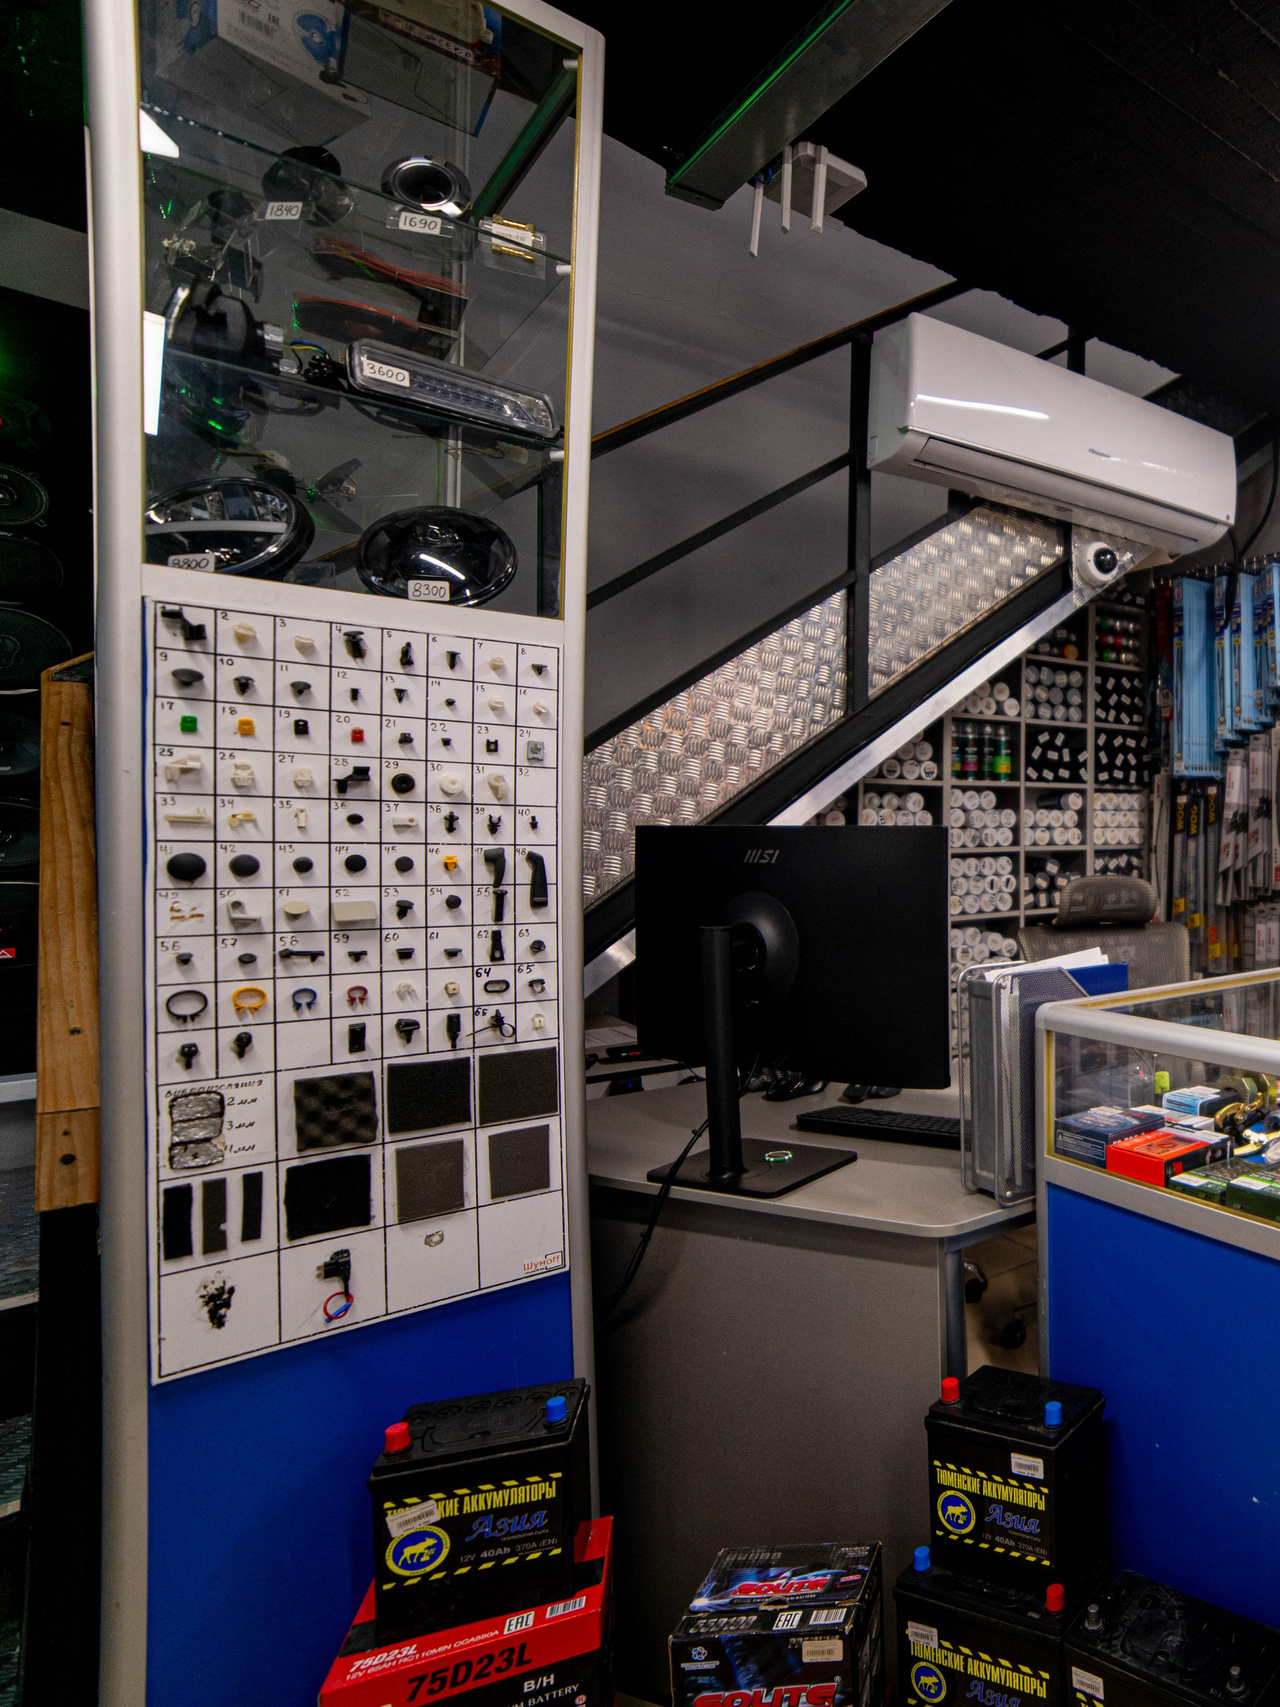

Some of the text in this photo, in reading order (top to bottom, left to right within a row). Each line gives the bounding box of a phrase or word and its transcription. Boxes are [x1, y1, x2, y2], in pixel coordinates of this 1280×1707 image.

[269, 203, 300, 217] 1840
[402, 215, 438, 231] 1690
[366, 362, 406, 383] 3600
[1087, 447, 1112, 460] Hisense
[411, 580, 447, 599] 8300
[220, 611, 230, 620] 2
[279, 618, 286, 627] 3
[520, 647, 527, 655] 8
[159, 651, 168, 661] 9
[219, 658, 235, 666] 10
[280, 664, 289, 672] 11
[336, 671, 348, 679] 12
[385, 675, 395, 683] 13
[431, 679, 441, 687] 14
[476, 684, 486, 692] 15
[160, 701, 175, 710] 17
[222, 706, 237, 715] 18
[278, 709, 291, 718] 19
[335, 715, 351, 723] 20
[385, 719, 396, 728] 21
[430, 722, 448, 732] 22
[477, 725, 490, 734] 23
[519, 729, 531, 738] 24
[158, 748, 174, 757] 25
[219, 752, 236, 760] 26
[278, 754, 295, 763] 27
[334, 757, 349, 766] 28
[384, 760, 399, 769] 29
[429, 763, 443, 771] 30
[475, 766, 485, 774] 31
[517, 768, 530, 777] 32
[160, 796, 176, 806] 33
[219, 799, 235, 808] 34
[278, 800, 293, 809] 35
[333, 802, 347, 810] 36
[385, 803, 400, 812] 37
[429, 805, 442, 813] 38
[475, 807, 485, 815] 39
[517, 808, 531, 816] 40
[1190, 804, 1198, 835] WOG
[220, 844, 236, 853] 42
[278, 845, 295, 854] 43
[384, 845, 397, 854] 45
[428, 847, 440, 855] 46
[515, 847, 527, 856] 48
[278, 889, 290, 898] 51
[335, 888, 350, 897] 52
[384, 887, 399, 897] 53
[429, 887, 443, 896] 54
[476, 887, 491, 897] 55
[429, 931, 439, 941] 61
[477, 931, 489, 939] 62
[518, 928, 530, 938] 63
[279, 936, 299, 948] 58
[333, 933, 350, 944] 59
[384, 933, 399, 943] 60
[221, 937, 238, 949] 57
[475, 967, 492, 978] 64
[517, 964, 536, 975] 65
[936, 1467, 1046, 1511] ТЮМЕНСКИЕ АККУМУЛЯТОРЫ
[462, 1480, 556, 1515] АККУМУЛЯТОРЫ
[984, 1503, 1041, 1534] Азия
[464, 1510, 548, 1542] Азия
[995, 1536, 1016, 1547] 40Ah
[460, 1537, 558, 1563] 12V 40Ah 370A (EN)
[506, 1613, 533, 1633] EAC
[777, 1612, 801, 1628] EAC
[349, 1644, 418, 1673] 75D23L
[407, 1642, 533, 1702] 75D23L
[523, 1674, 555, 1694] B/H
[967, 1660, 1047, 1699] АККУМУЛЯТОРЫ
[528, 1683, 580, 1707] BATTERY
